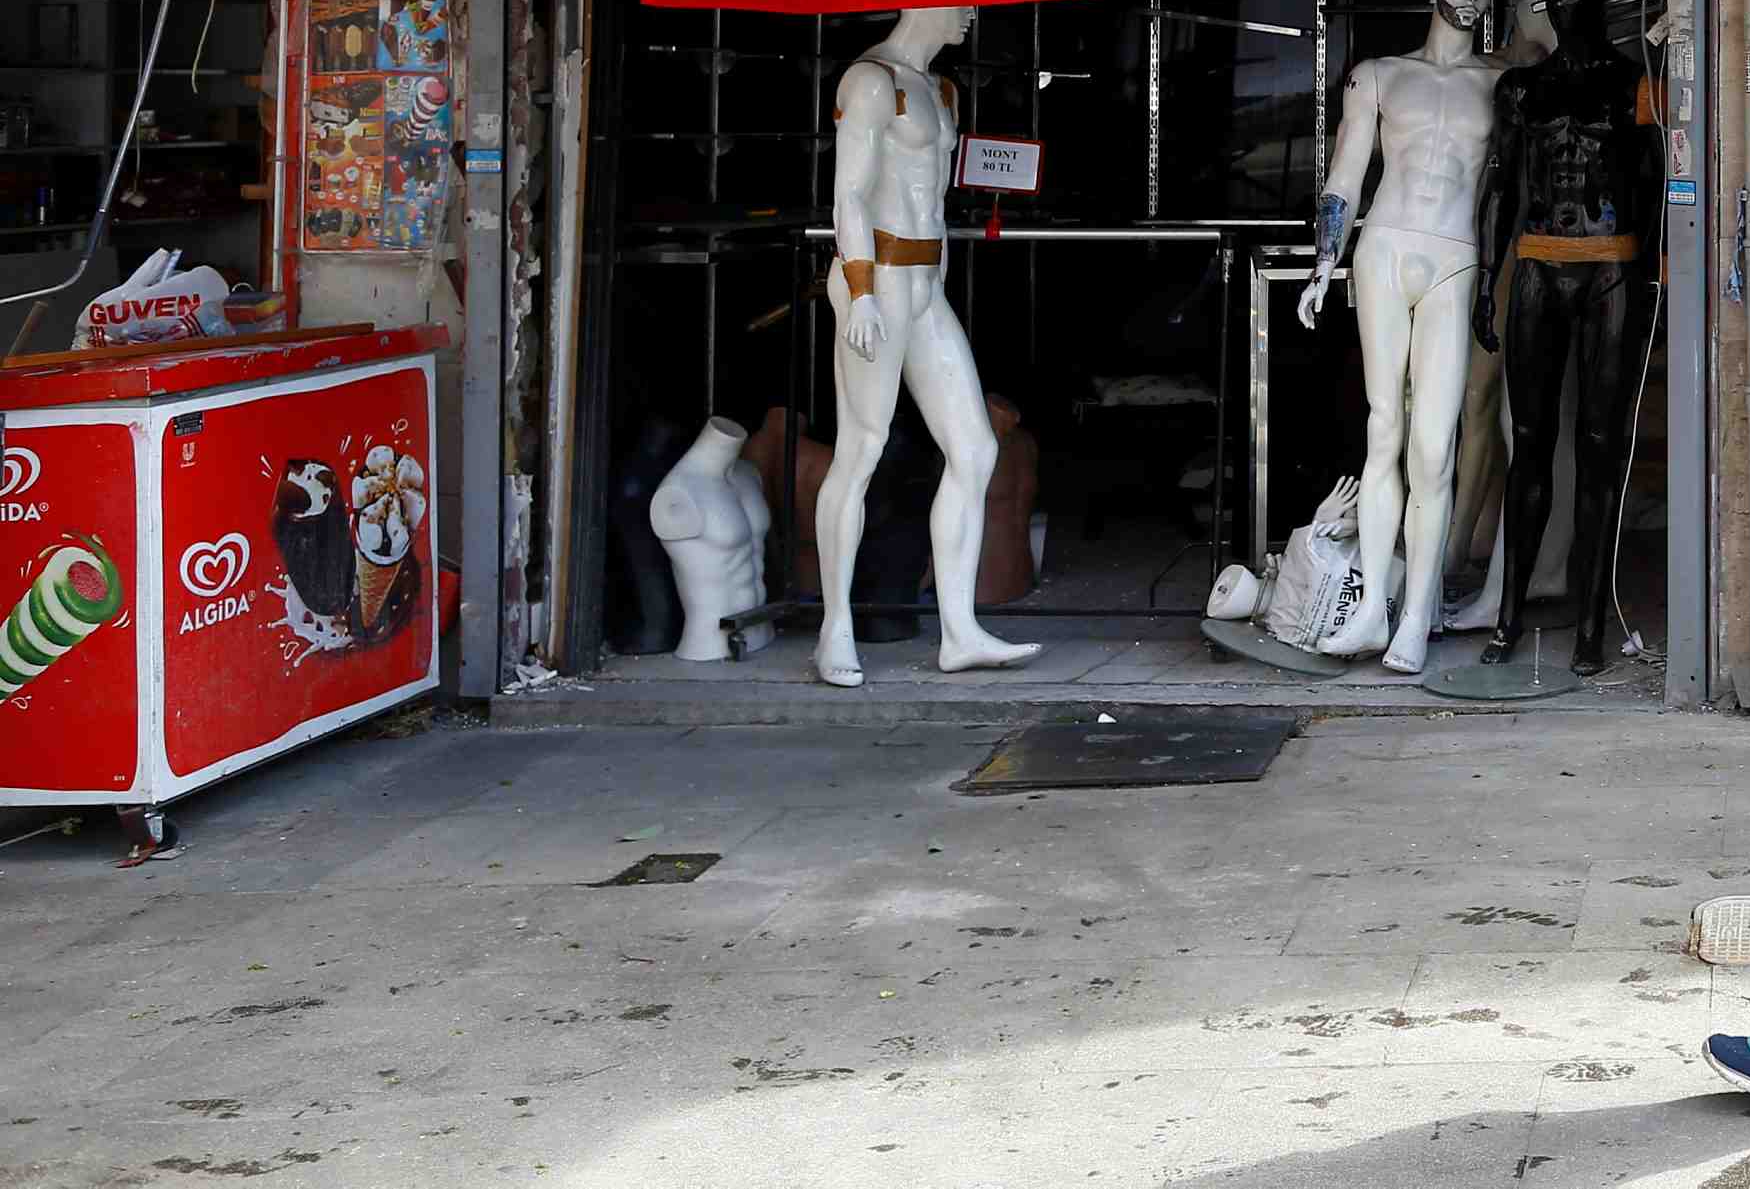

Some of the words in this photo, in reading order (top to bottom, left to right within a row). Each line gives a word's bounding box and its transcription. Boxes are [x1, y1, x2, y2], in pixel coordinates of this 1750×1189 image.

[982, 147, 1018, 160] MONT
[983, 162, 995, 172] 80
[1000, 163, 1014, 173] TL
